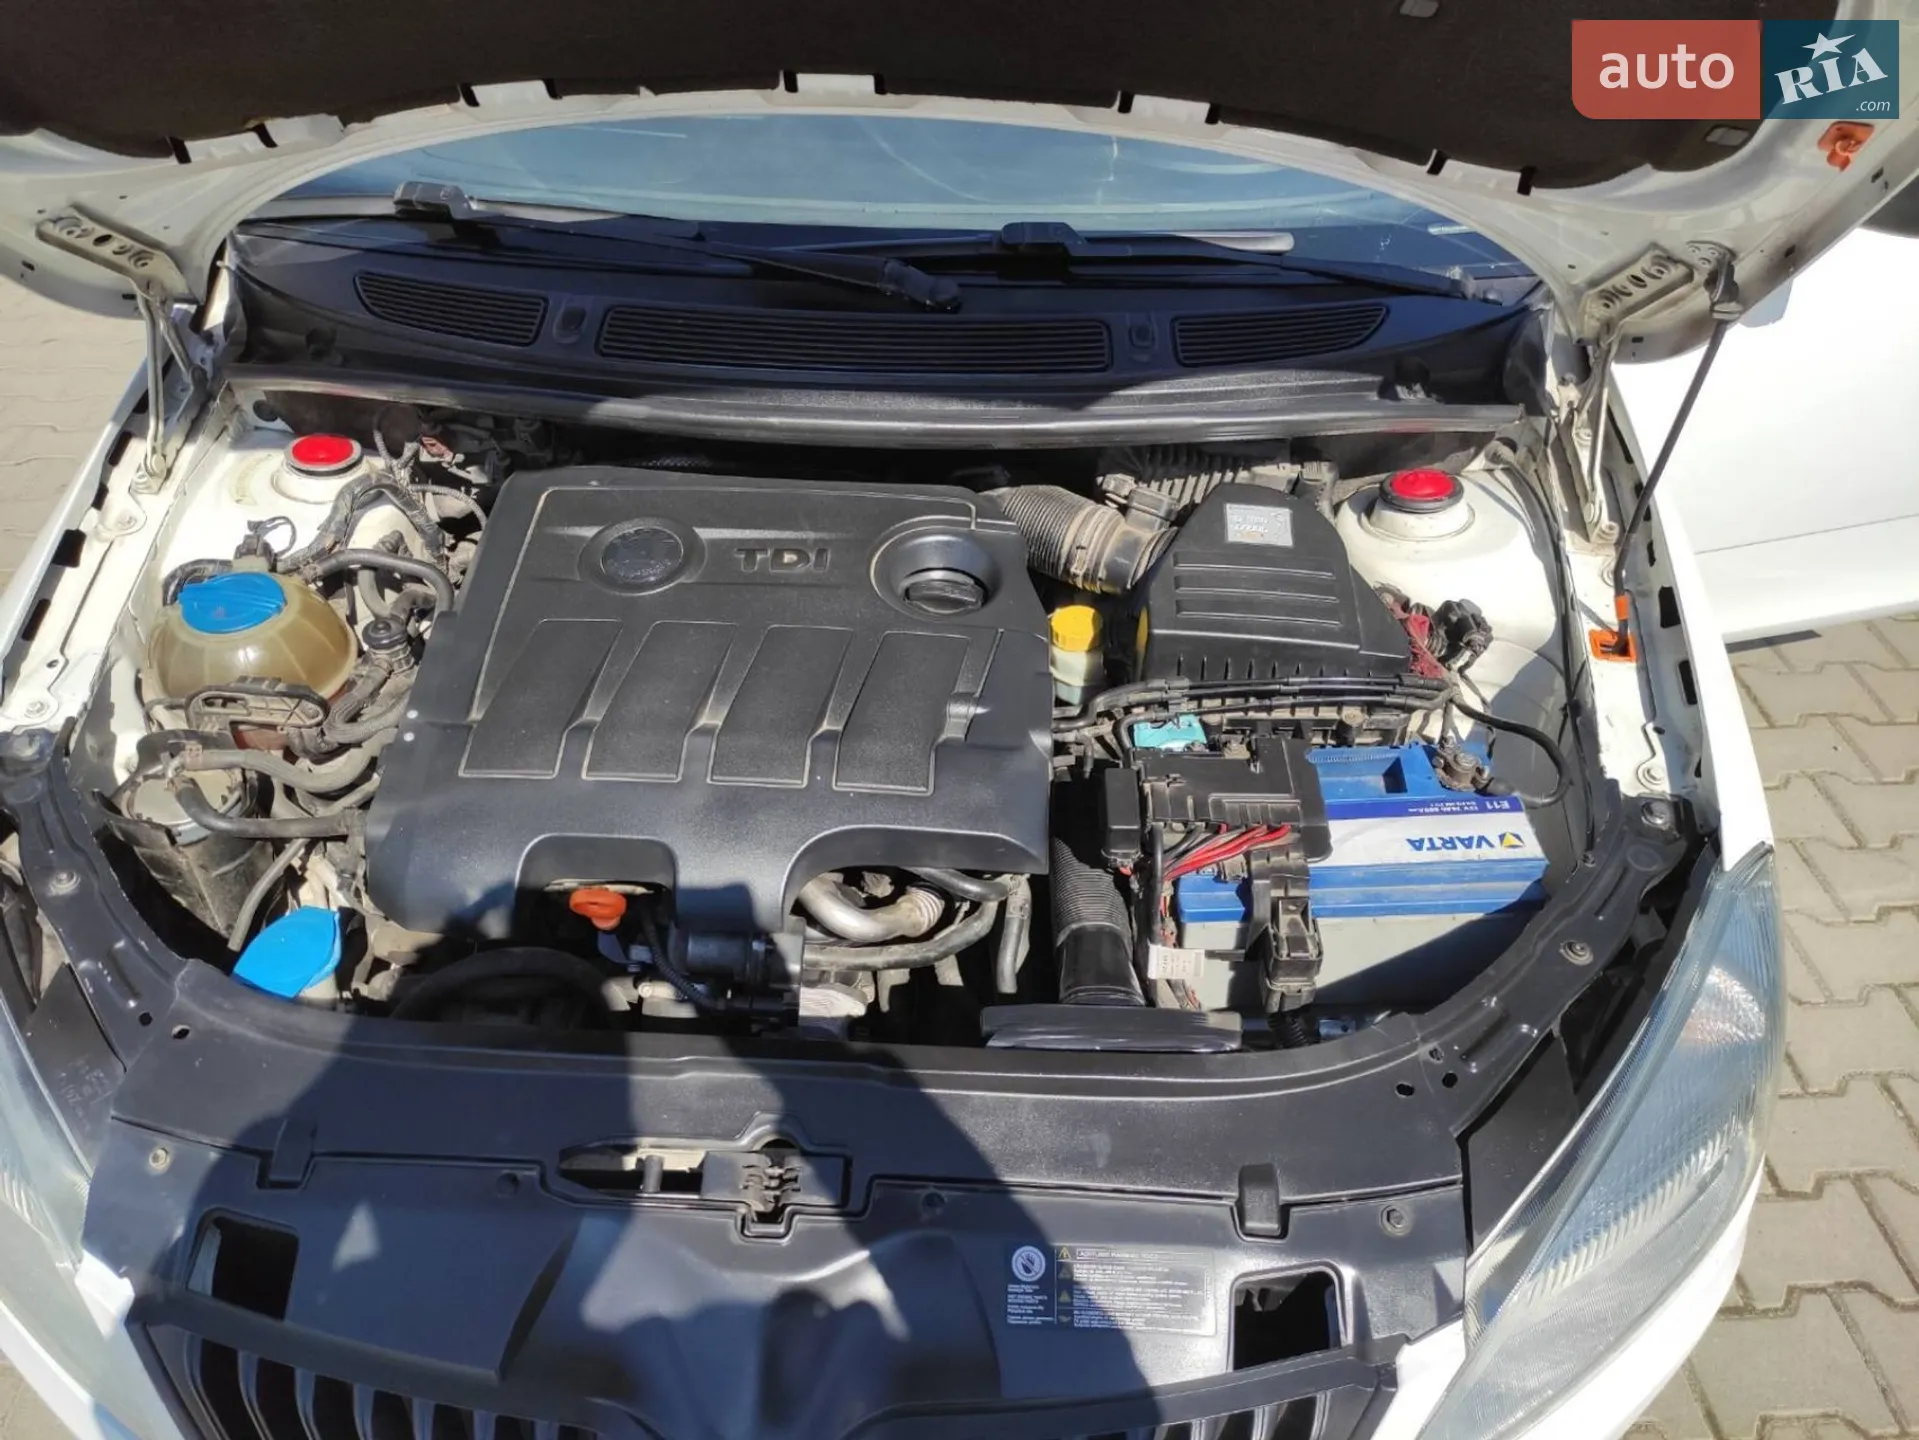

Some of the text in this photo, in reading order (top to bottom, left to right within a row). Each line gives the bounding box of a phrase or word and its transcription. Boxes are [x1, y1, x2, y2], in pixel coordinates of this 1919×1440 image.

[733, 547, 831, 575] TDI
[1485, 799, 1511, 810] E11
[1405, 835, 1496, 851] VARTA
